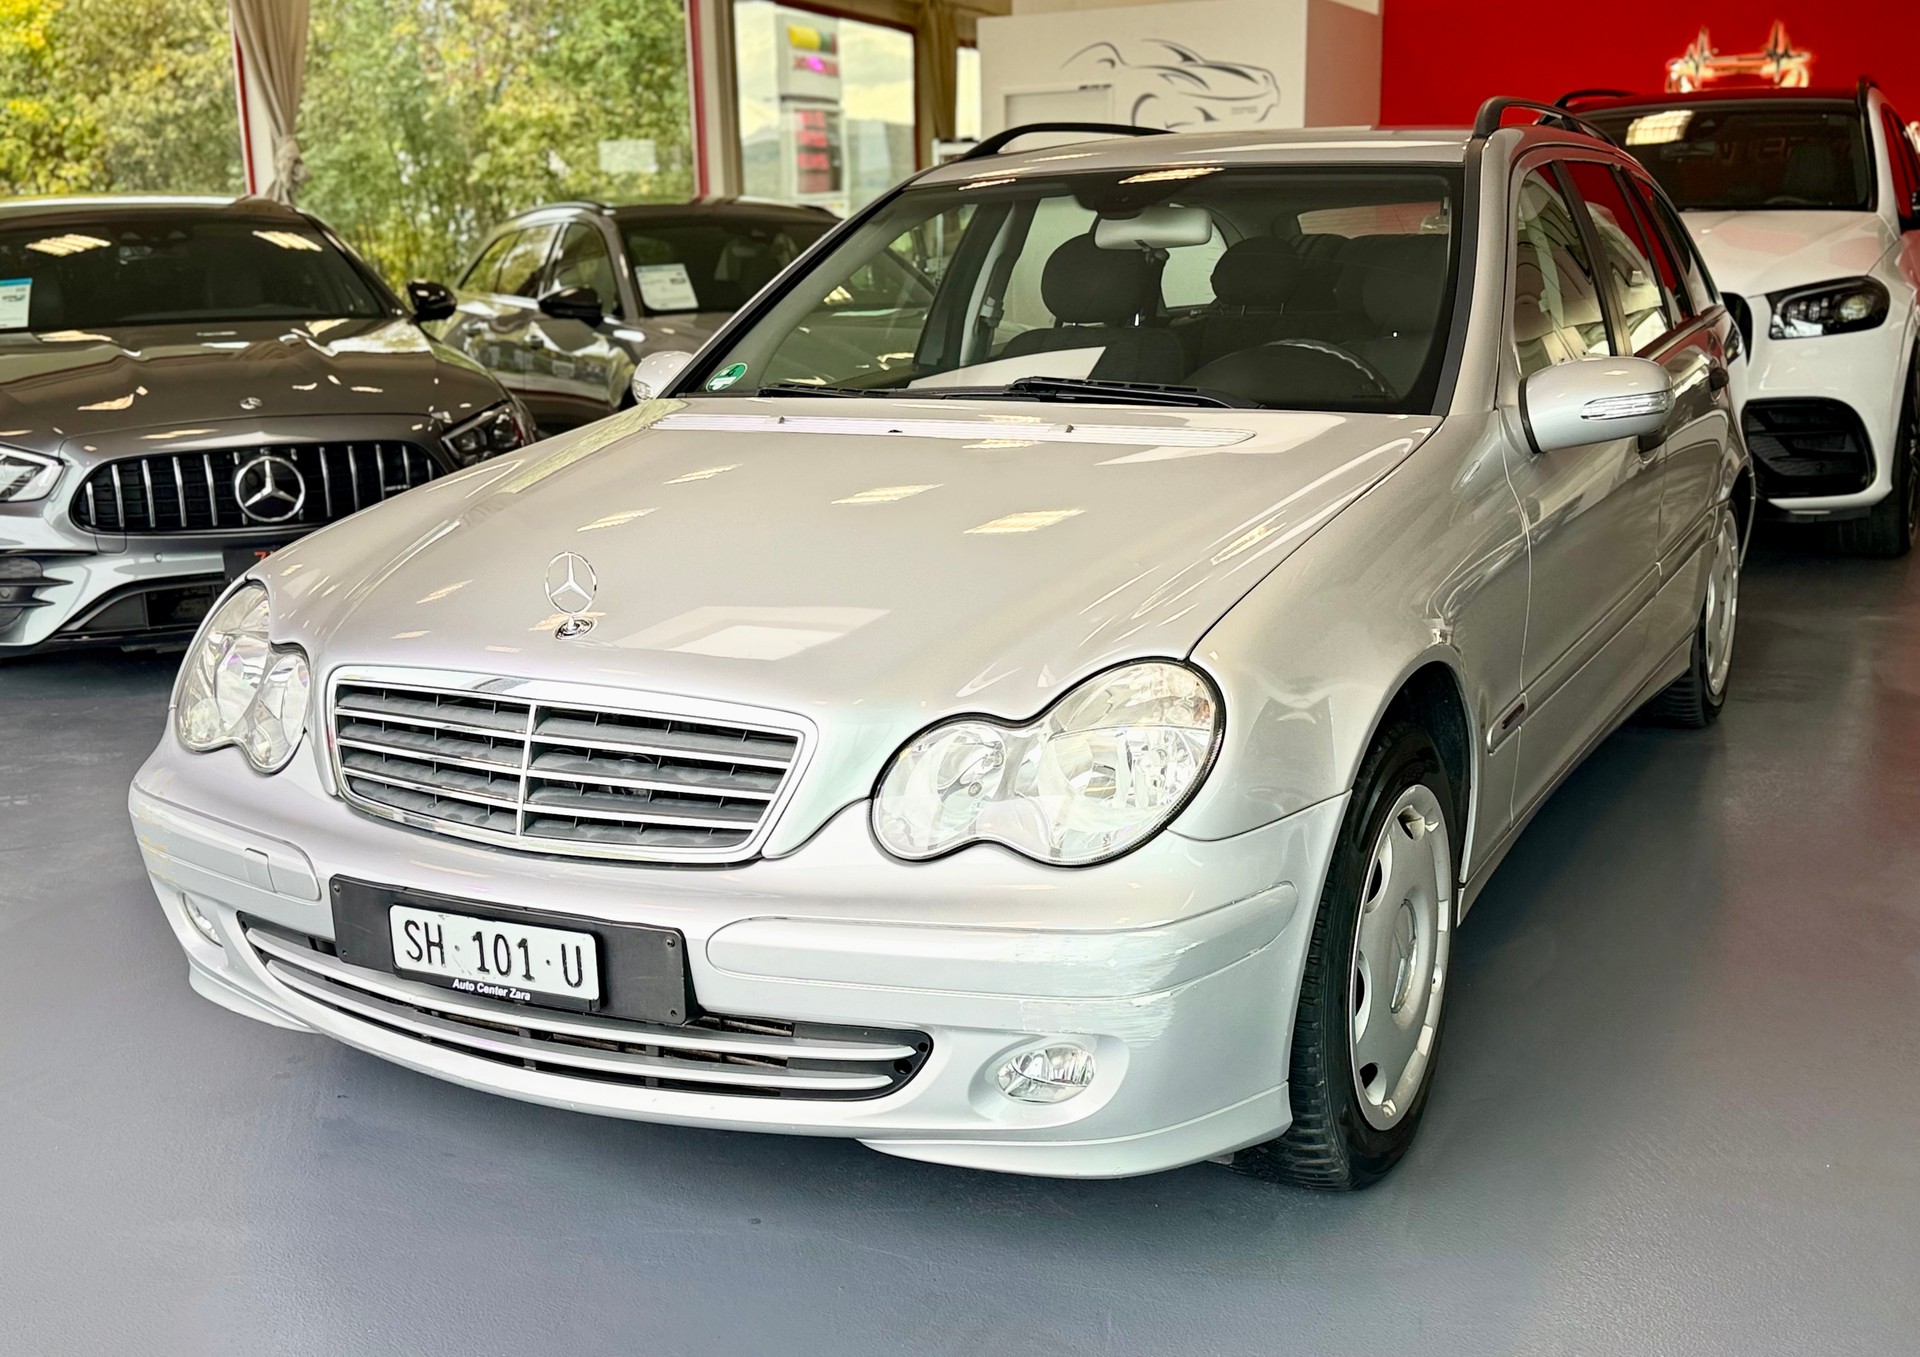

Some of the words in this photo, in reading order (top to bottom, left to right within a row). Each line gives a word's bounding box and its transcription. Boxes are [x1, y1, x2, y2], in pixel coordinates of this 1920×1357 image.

[453, 978, 475, 992] Auto
[477, 983, 508, 998] Center
[509, 987, 531, 1001] Zara
